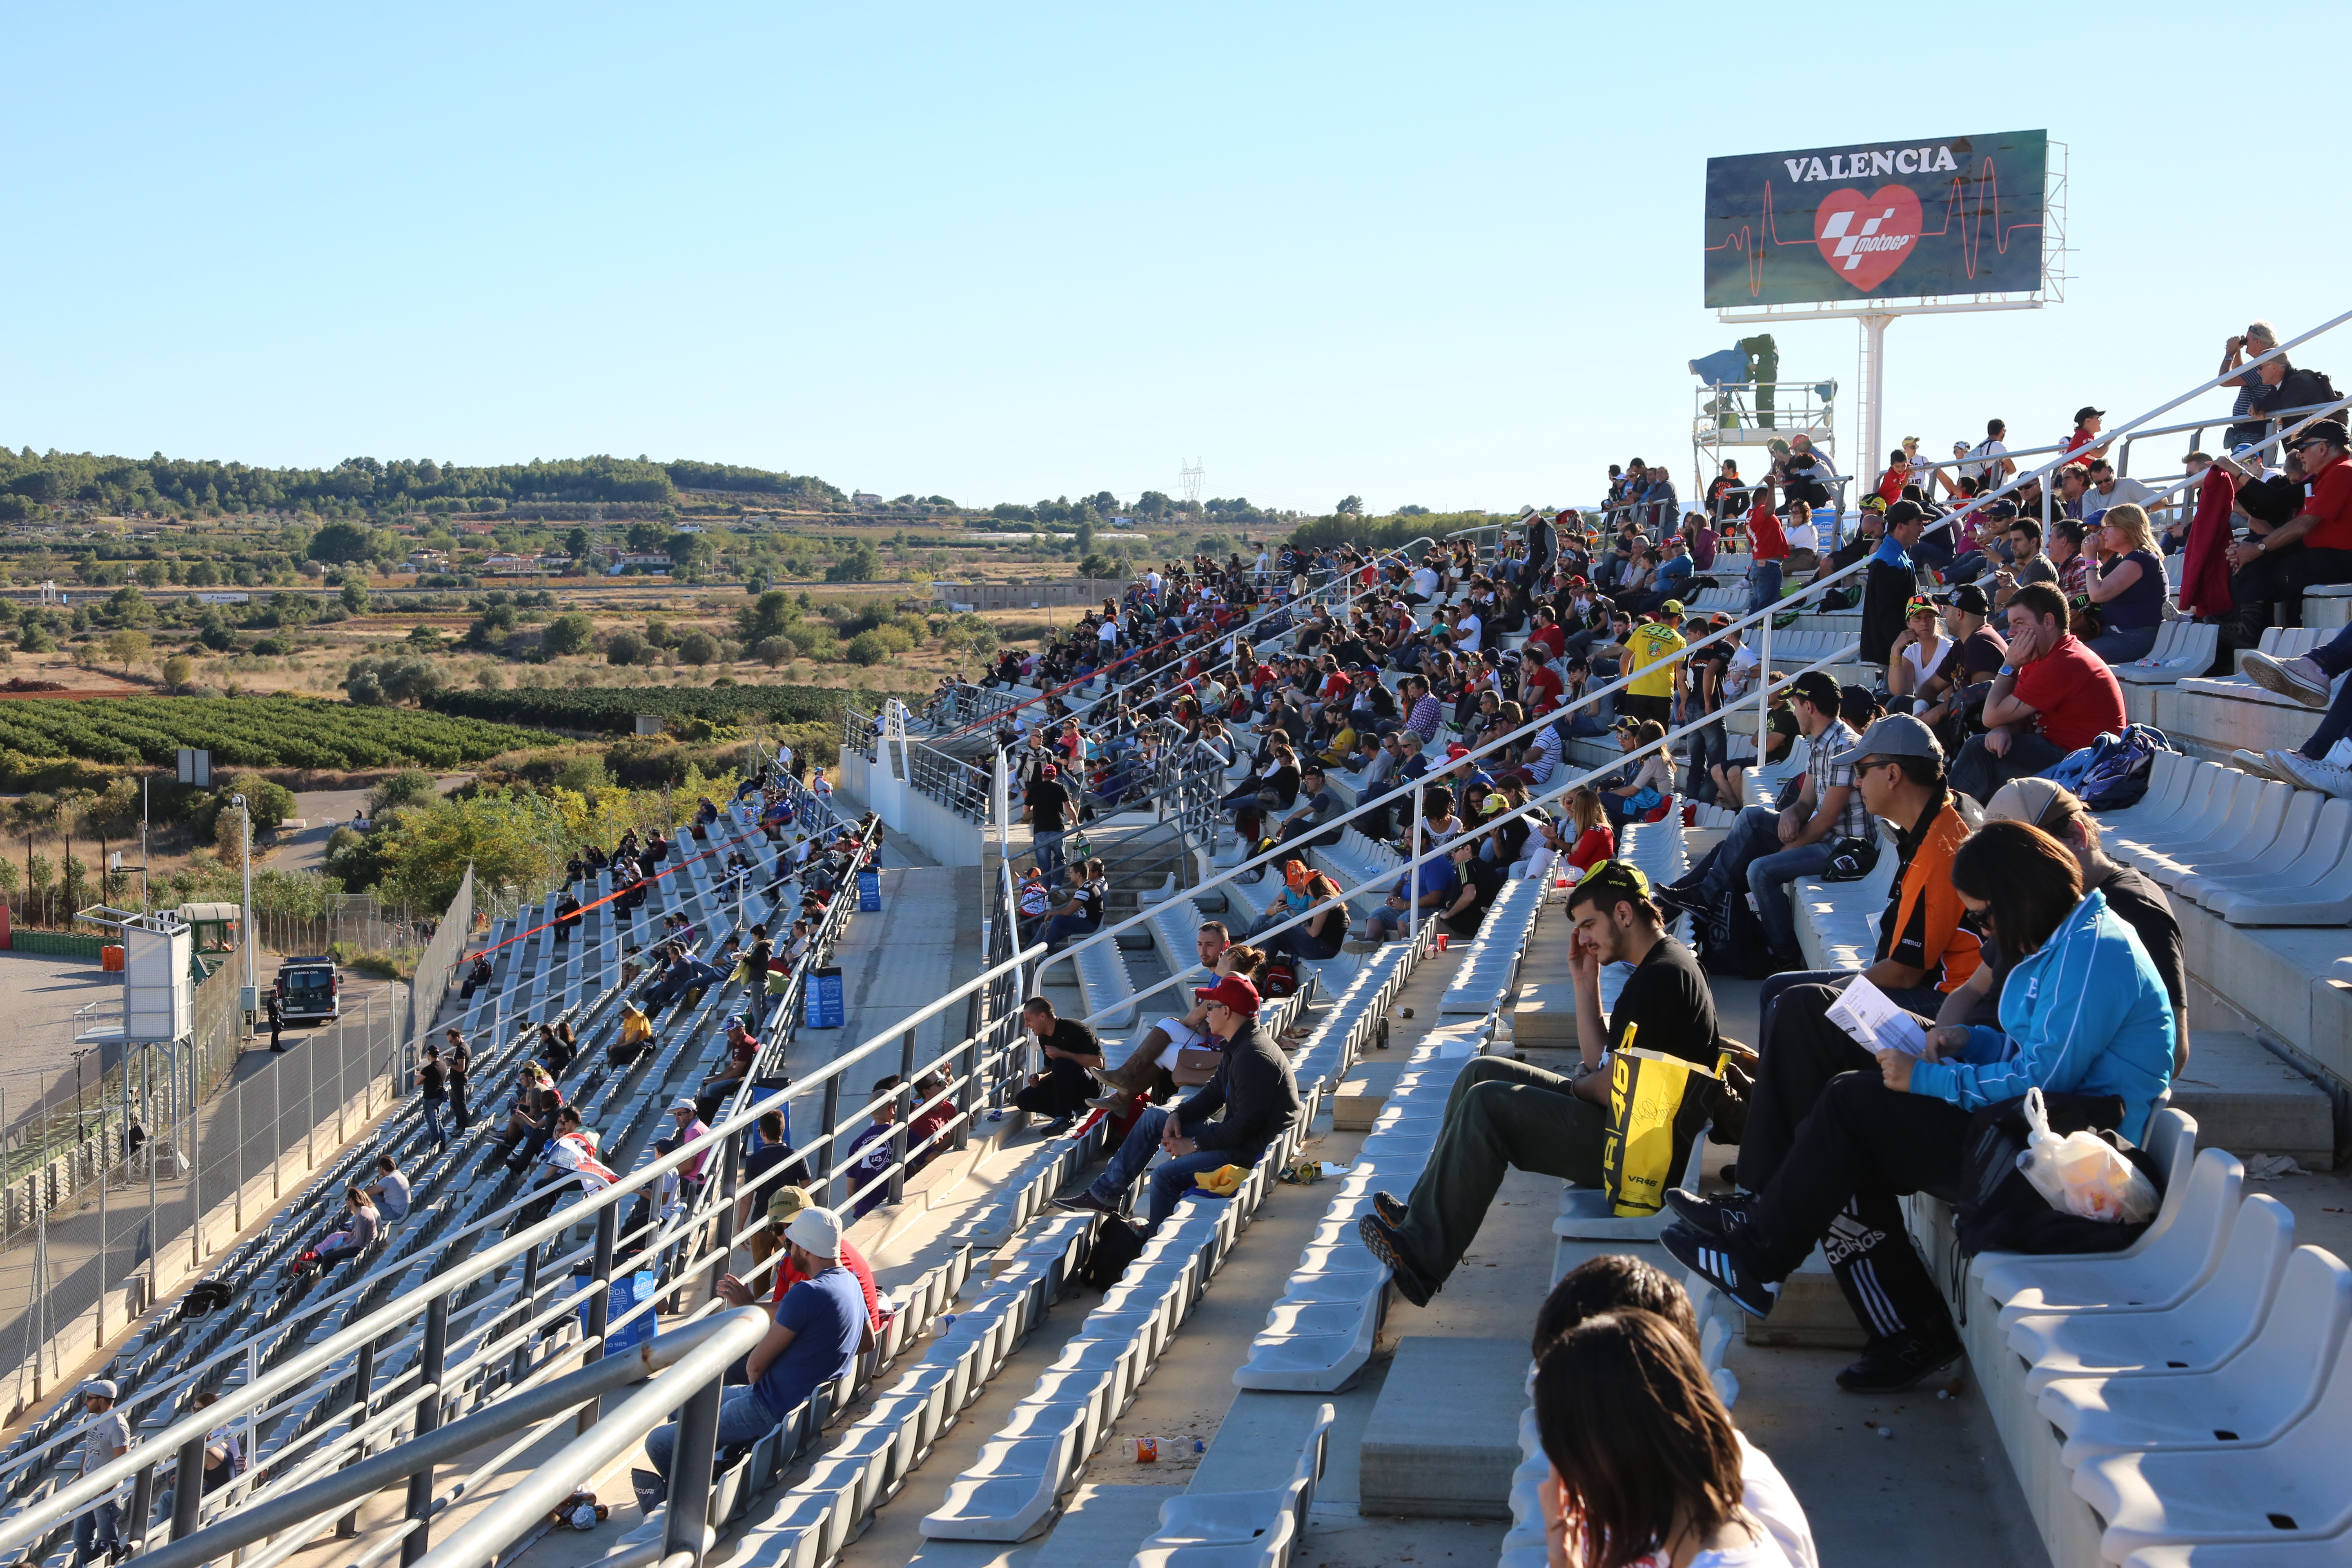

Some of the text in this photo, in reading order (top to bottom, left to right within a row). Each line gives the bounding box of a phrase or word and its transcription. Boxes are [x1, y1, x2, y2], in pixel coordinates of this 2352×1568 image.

[1784, 146, 1958, 183] VALENCIA
[1643, 625, 1674, 640] 46
[1503, 675, 1512, 688] 3
[158, 912, 175, 931] 14
[1902, 938, 1921, 947] GENERALI
[1628, 1175, 1658, 1187] VR46
[1827, 1230, 1886, 1264] adidas
[633, 1280, 652, 1292] RECUERDA
